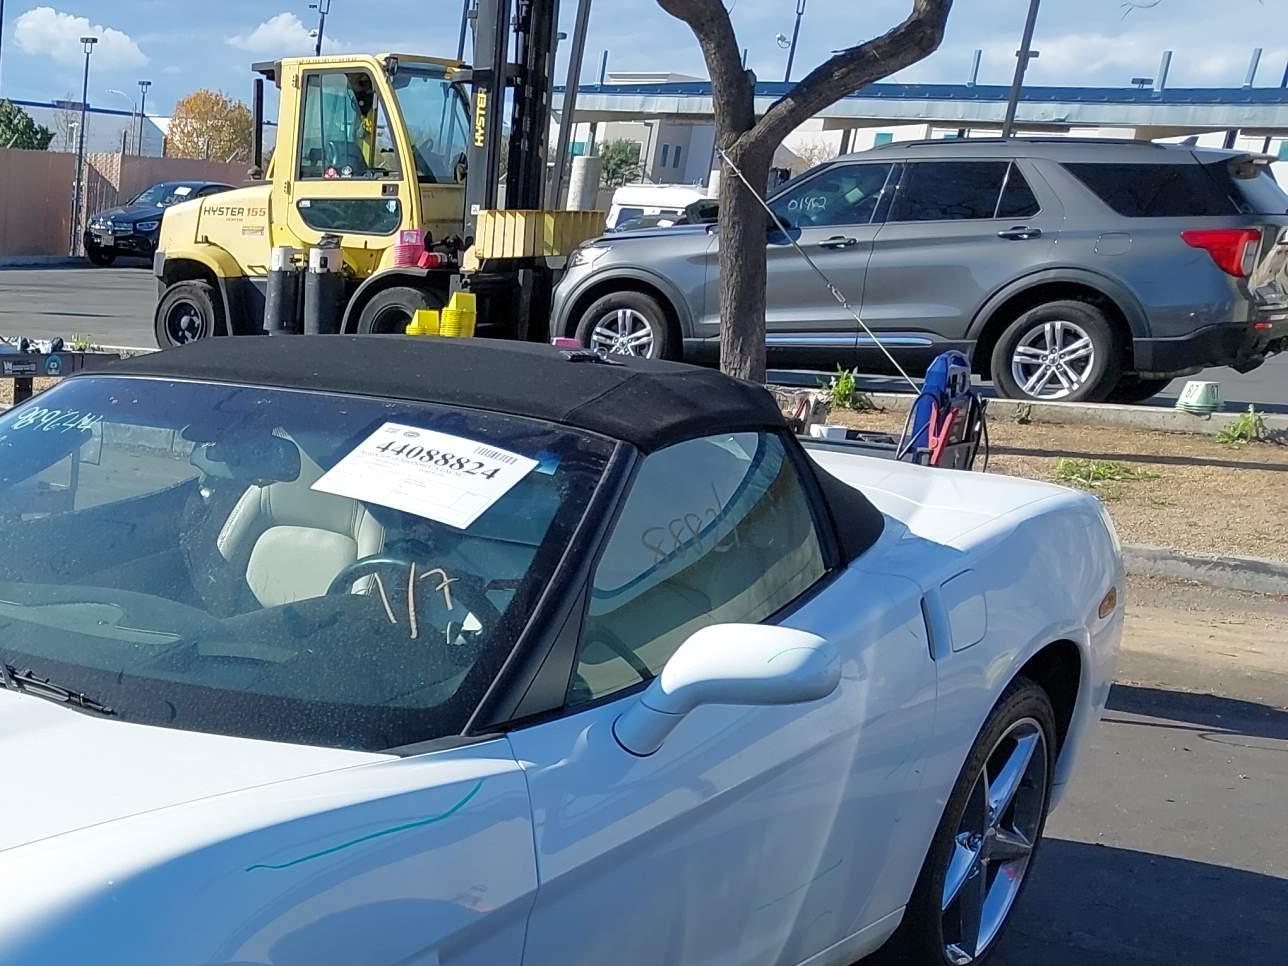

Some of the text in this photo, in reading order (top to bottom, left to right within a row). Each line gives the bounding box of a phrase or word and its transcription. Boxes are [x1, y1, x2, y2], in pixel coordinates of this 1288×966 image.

[474, 87, 488, 147] HYSTER
[203, 206, 267, 217] HYSTER 155
[375, 440, 502, 480] 44088824
